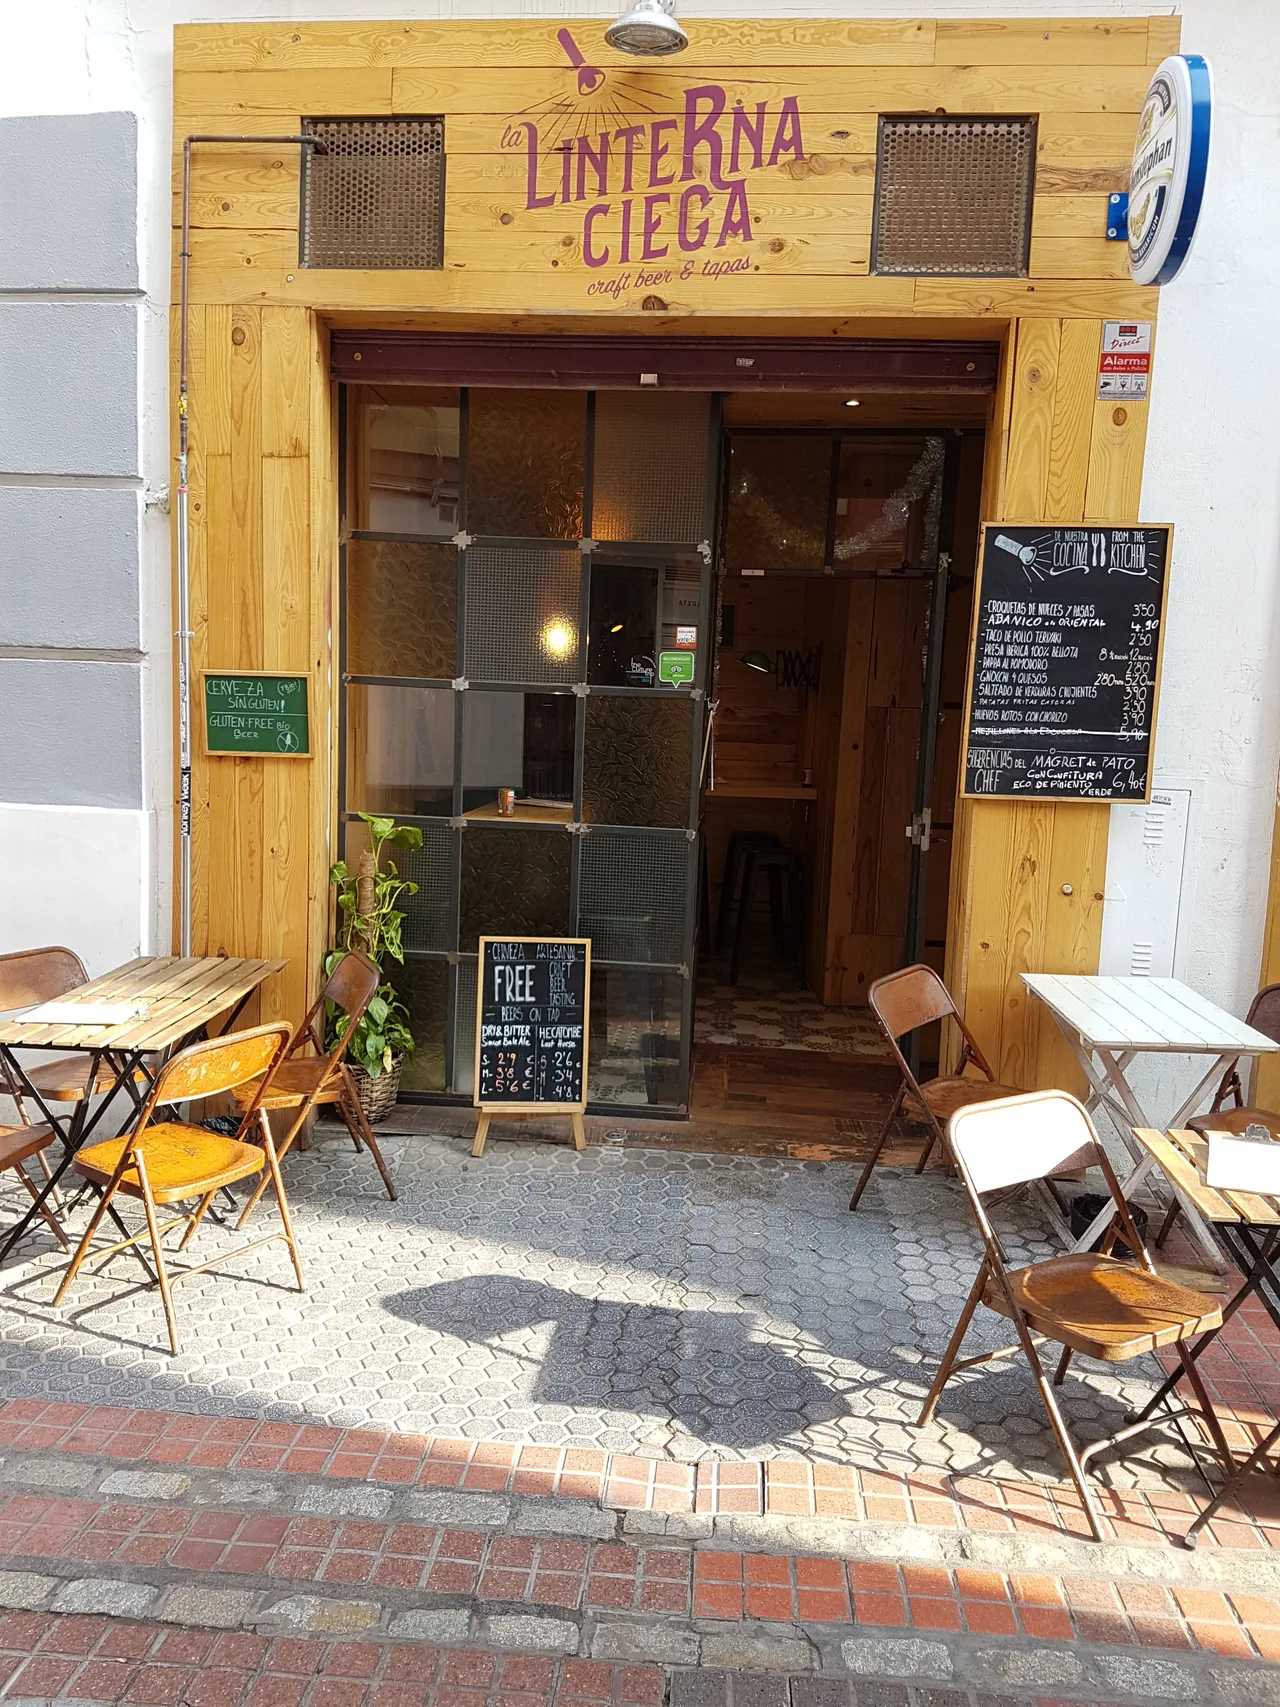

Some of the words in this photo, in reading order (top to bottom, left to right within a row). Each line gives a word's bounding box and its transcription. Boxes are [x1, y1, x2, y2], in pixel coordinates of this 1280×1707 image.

[500, 124, 524, 148] la
[520, 85, 806, 210] LINTERNA
[583, 180, 754, 268] CIEGA
[587, 273, 632, 300] craft
[634, 268, 672, 290] beer
[680, 261, 694, 280] &
[702, 256, 751, 281] tapas
[1110, 336, 1146, 350] Direct
[1104, 356, 1148, 366] Alarma
[1054, 530, 1060, 542] DE
[1064, 531, 1088, 542] NUESTRA
[1112, 530, 1129, 542] FROM
[1132, 531, 1144, 542] THE
[1054, 542, 1088, 566] COCINA
[1110, 543, 1146, 568] KITCHEN
[1028, 602, 1036, 615] DE
[1038, 603, 1063, 616] NUECES
[1073, 605, 1095, 617] PASAS
[1132, 603, 1155, 616] 3'50
[1058, 618, 1106, 627] ORIENTAL
[1131, 620, 1159, 632] 4.90
[1004, 630, 1011, 642] DE
[1012, 630, 1033, 643] POLLO
[1035, 631, 1062, 644] TERIYAKI
[1129, 633, 1151, 646] 2'50
[1006, 642, 1028, 657] IBÉRICA
[1031, 645, 1049, 657] 100%
[1051, 646, 1079, 658] BELLOTA
[1099, 648, 1107, 661] 8
[1129, 648, 1139, 660] 12
[1002, 658, 1009, 669] AL
[1010, 658, 1048, 670] POMODORO
[1126, 661, 1150, 674] 2'80
[1018, 672, 1048, 684] QUESOS
[206, 680, 263, 696] CERVEZA
[1015, 686, 1022, 696] DE
[1024, 686, 1056, 697] VERDURAS
[1059, 686, 1097, 698] CRUJIENTES
[1123, 687, 1147, 700] 3'90
[248, 699, 285, 713] GLUTEN!
[1123, 699, 1146, 713] 2'50
[1001, 710, 1022, 721] ROTOS
[1025, 711, 1039, 722] CON
[1039, 712, 1068, 722] CHORIZO
[1122, 712, 1144, 726] 3'90
[967, 749, 1013, 769] SUGERENCIAS
[1014, 758, 1026, 769] DEL
[1031, 756, 1086, 769] MAGRET
[1087, 758, 1096, 767] de
[1102, 757, 1135, 770] PATO
[975, 769, 1002, 792] CHEF
[492, 943, 525, 960] CERVEZA
[536, 944, 576, 961] ARTESANAL
[549, 962, 572, 978] CRAFT
[494, 964, 536, 1002] FREE
[550, 978, 566, 992] BEER
[549, 992, 575, 1006] TASTING
[502, 1006, 523, 1022] BEERS
[529, 1007, 542, 1022] ON
[547, 1008, 560, 1022] TAP
[504, 1025, 531, 1036] BITTER
[540, 1027, 582, 1039] HECATOMBE
[518, 1038, 531, 1046] Ale
[498, 1053, 516, 1066] 2'9
[527, 1055, 534, 1064] €
[496, 1068, 514, 1079] 3'8
[525, 1067, 533, 1077] €
[496, 1080, 518, 1092] 5'6
[522, 1081, 531, 1090] €
